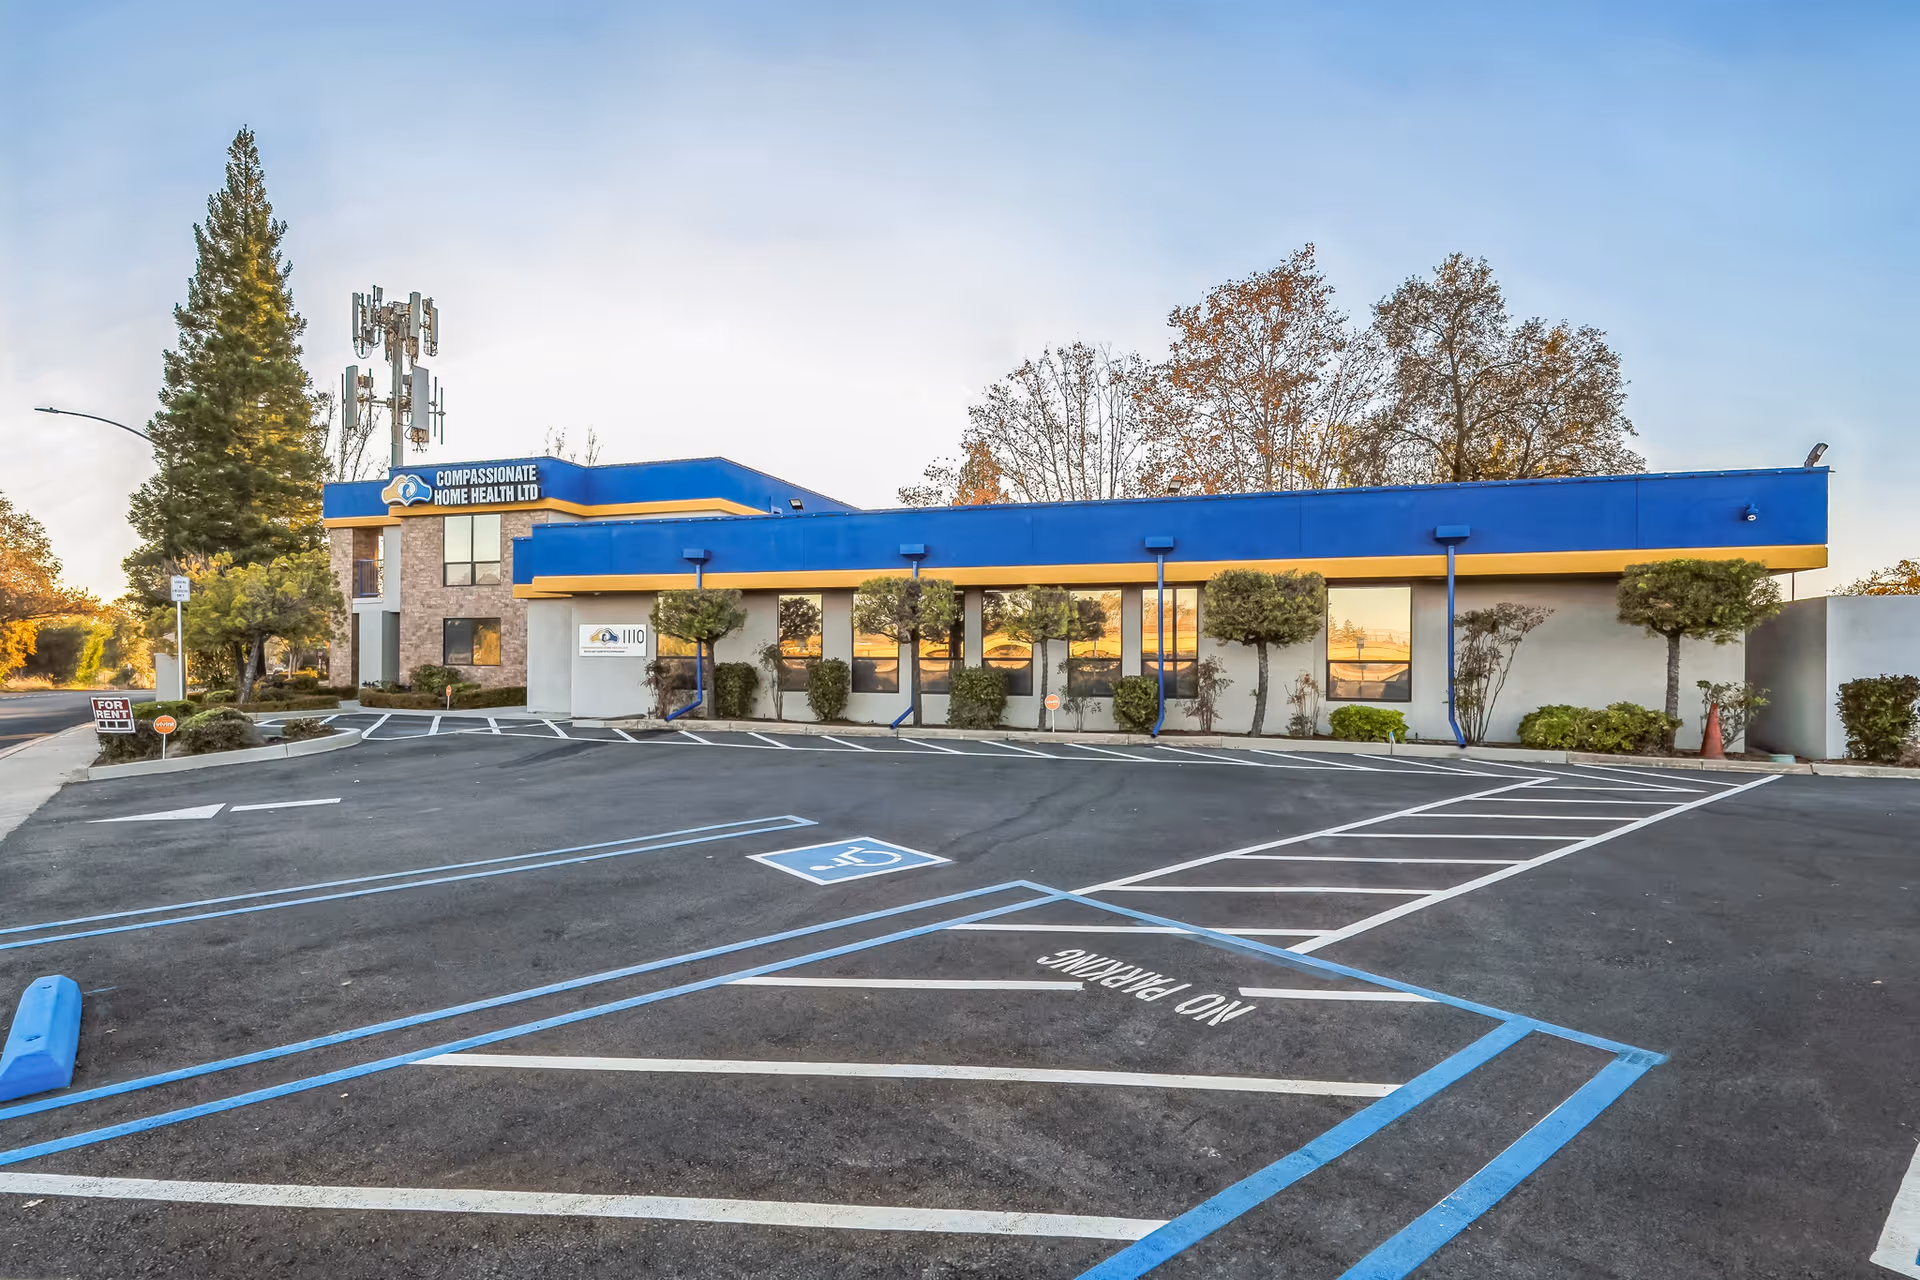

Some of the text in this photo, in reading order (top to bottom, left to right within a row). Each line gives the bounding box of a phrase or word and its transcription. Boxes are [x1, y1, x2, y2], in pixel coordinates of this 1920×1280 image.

[436, 464, 537, 487] COMPASSIONATE
[434, 484, 539, 506] HOME HEALTH LTD
[623, 629, 645, 644] 1110
[95, 709, 129, 719] RENT
[97, 700, 124, 710] FOR
[1036, 949, 1257, 1027] NO PARKING
